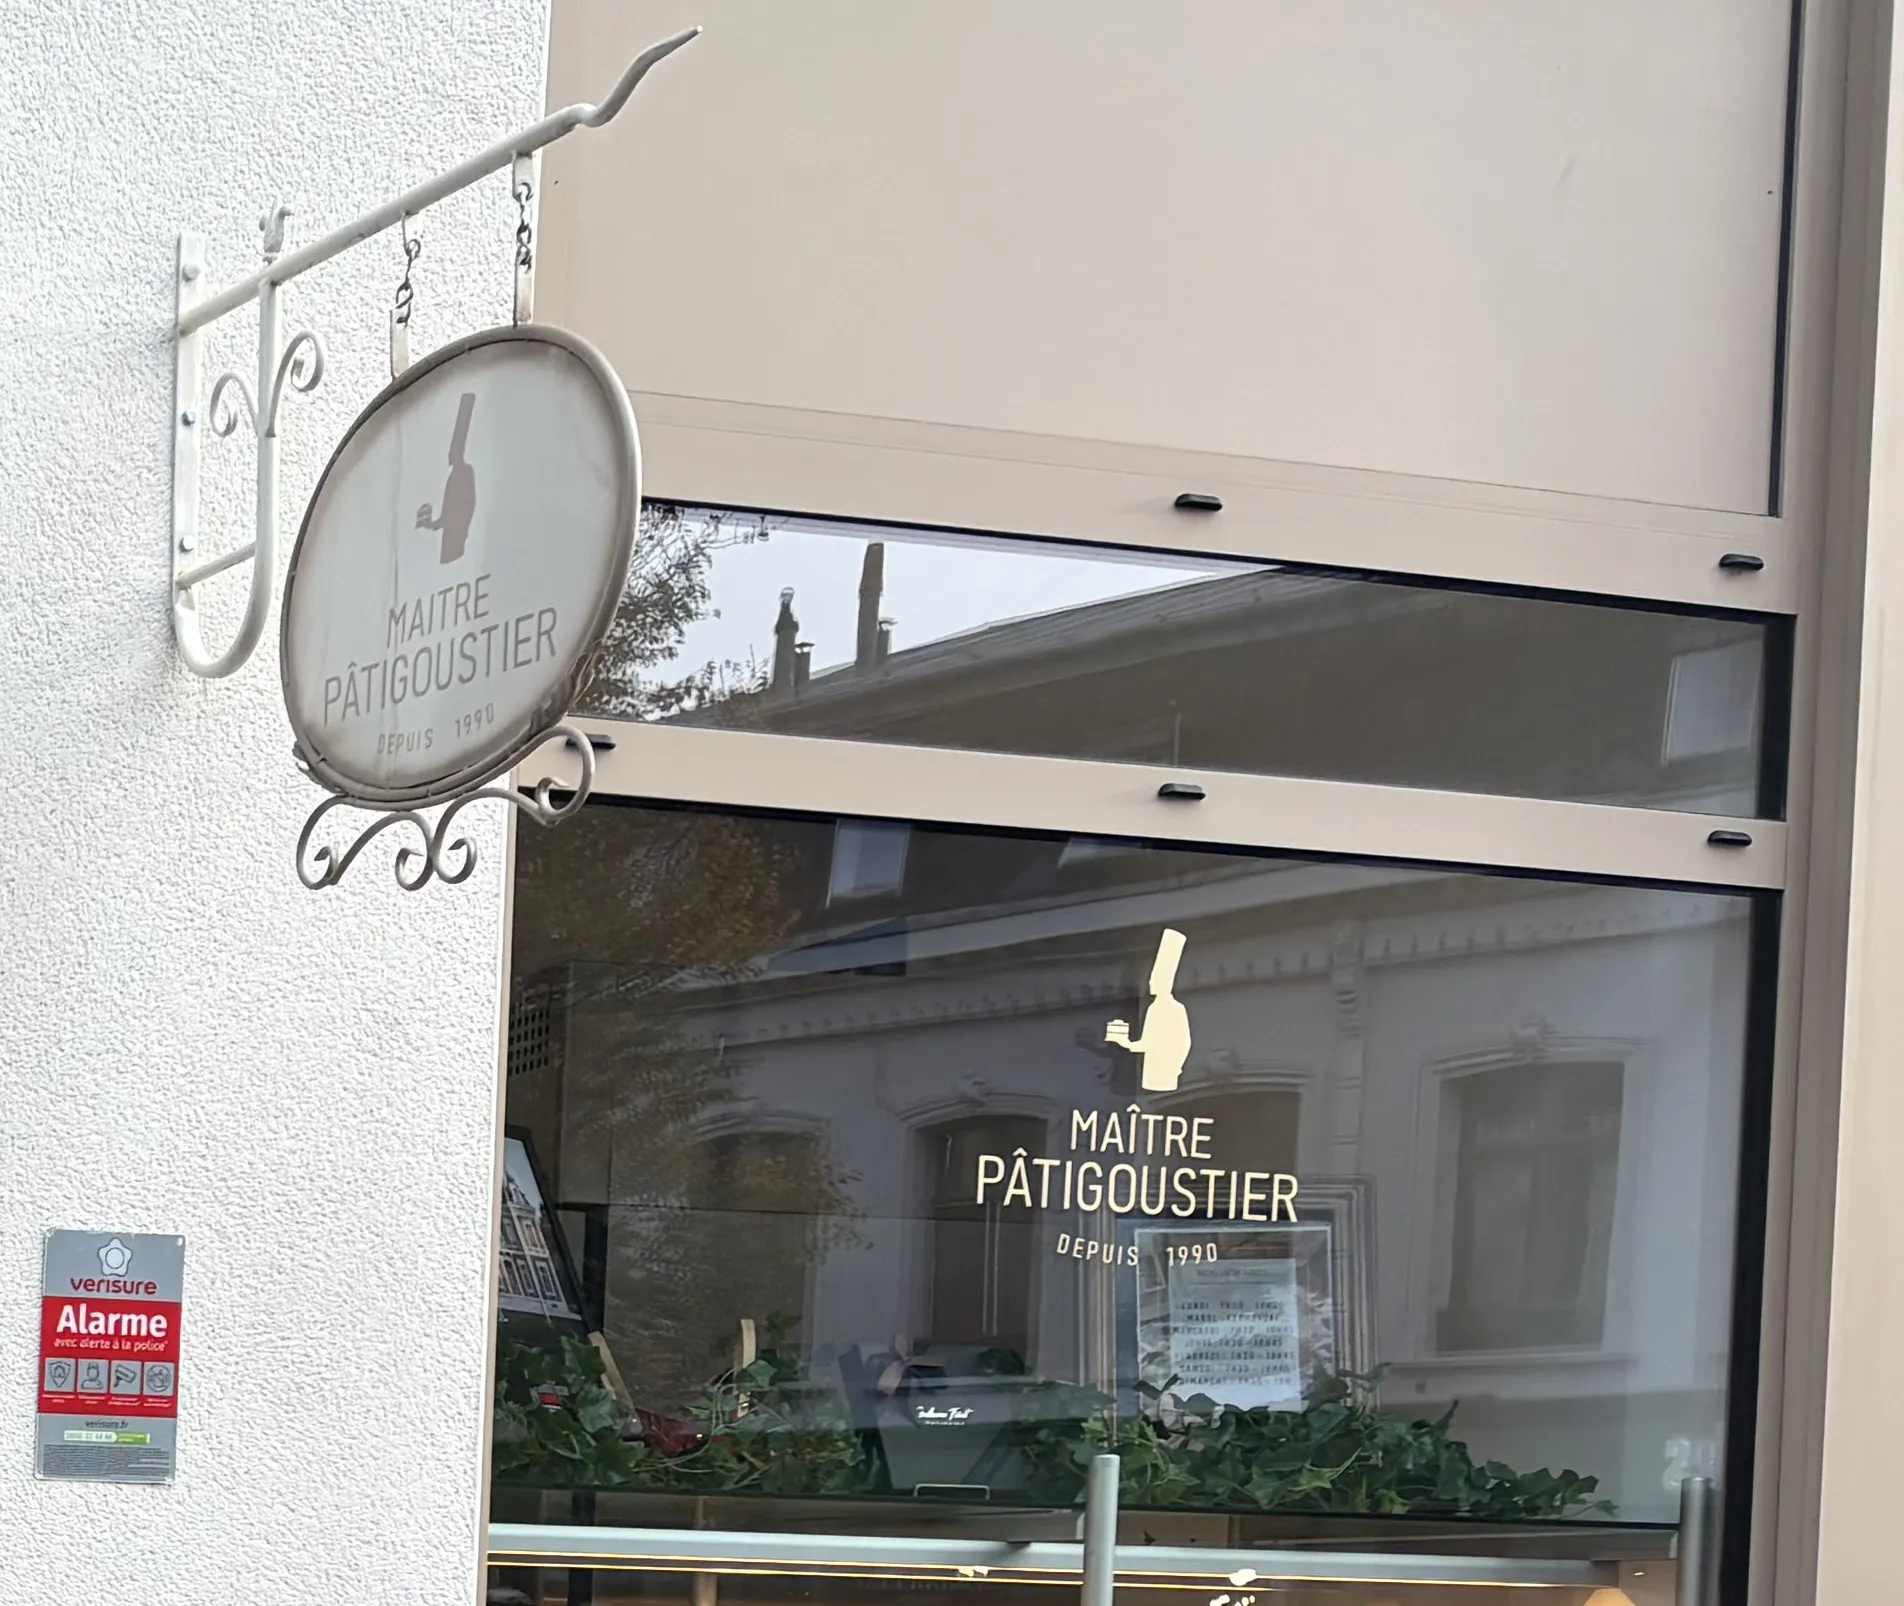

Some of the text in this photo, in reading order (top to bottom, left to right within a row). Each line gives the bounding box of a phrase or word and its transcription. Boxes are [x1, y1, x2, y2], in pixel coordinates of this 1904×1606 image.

[324, 606, 559, 728] PÂTIGOUSTIER
[377, 701, 496, 756] DEPUIS 1990
[1069, 1103, 1214, 1160] MAÎTRE
[975, 1147, 1299, 1223] PÂTIGOUSTIER
[1056, 1232, 1219, 1267] DEPUIS 1990
[70, 1277, 158, 1295] verisure
[56, 1303, 168, 1338] Alarme
